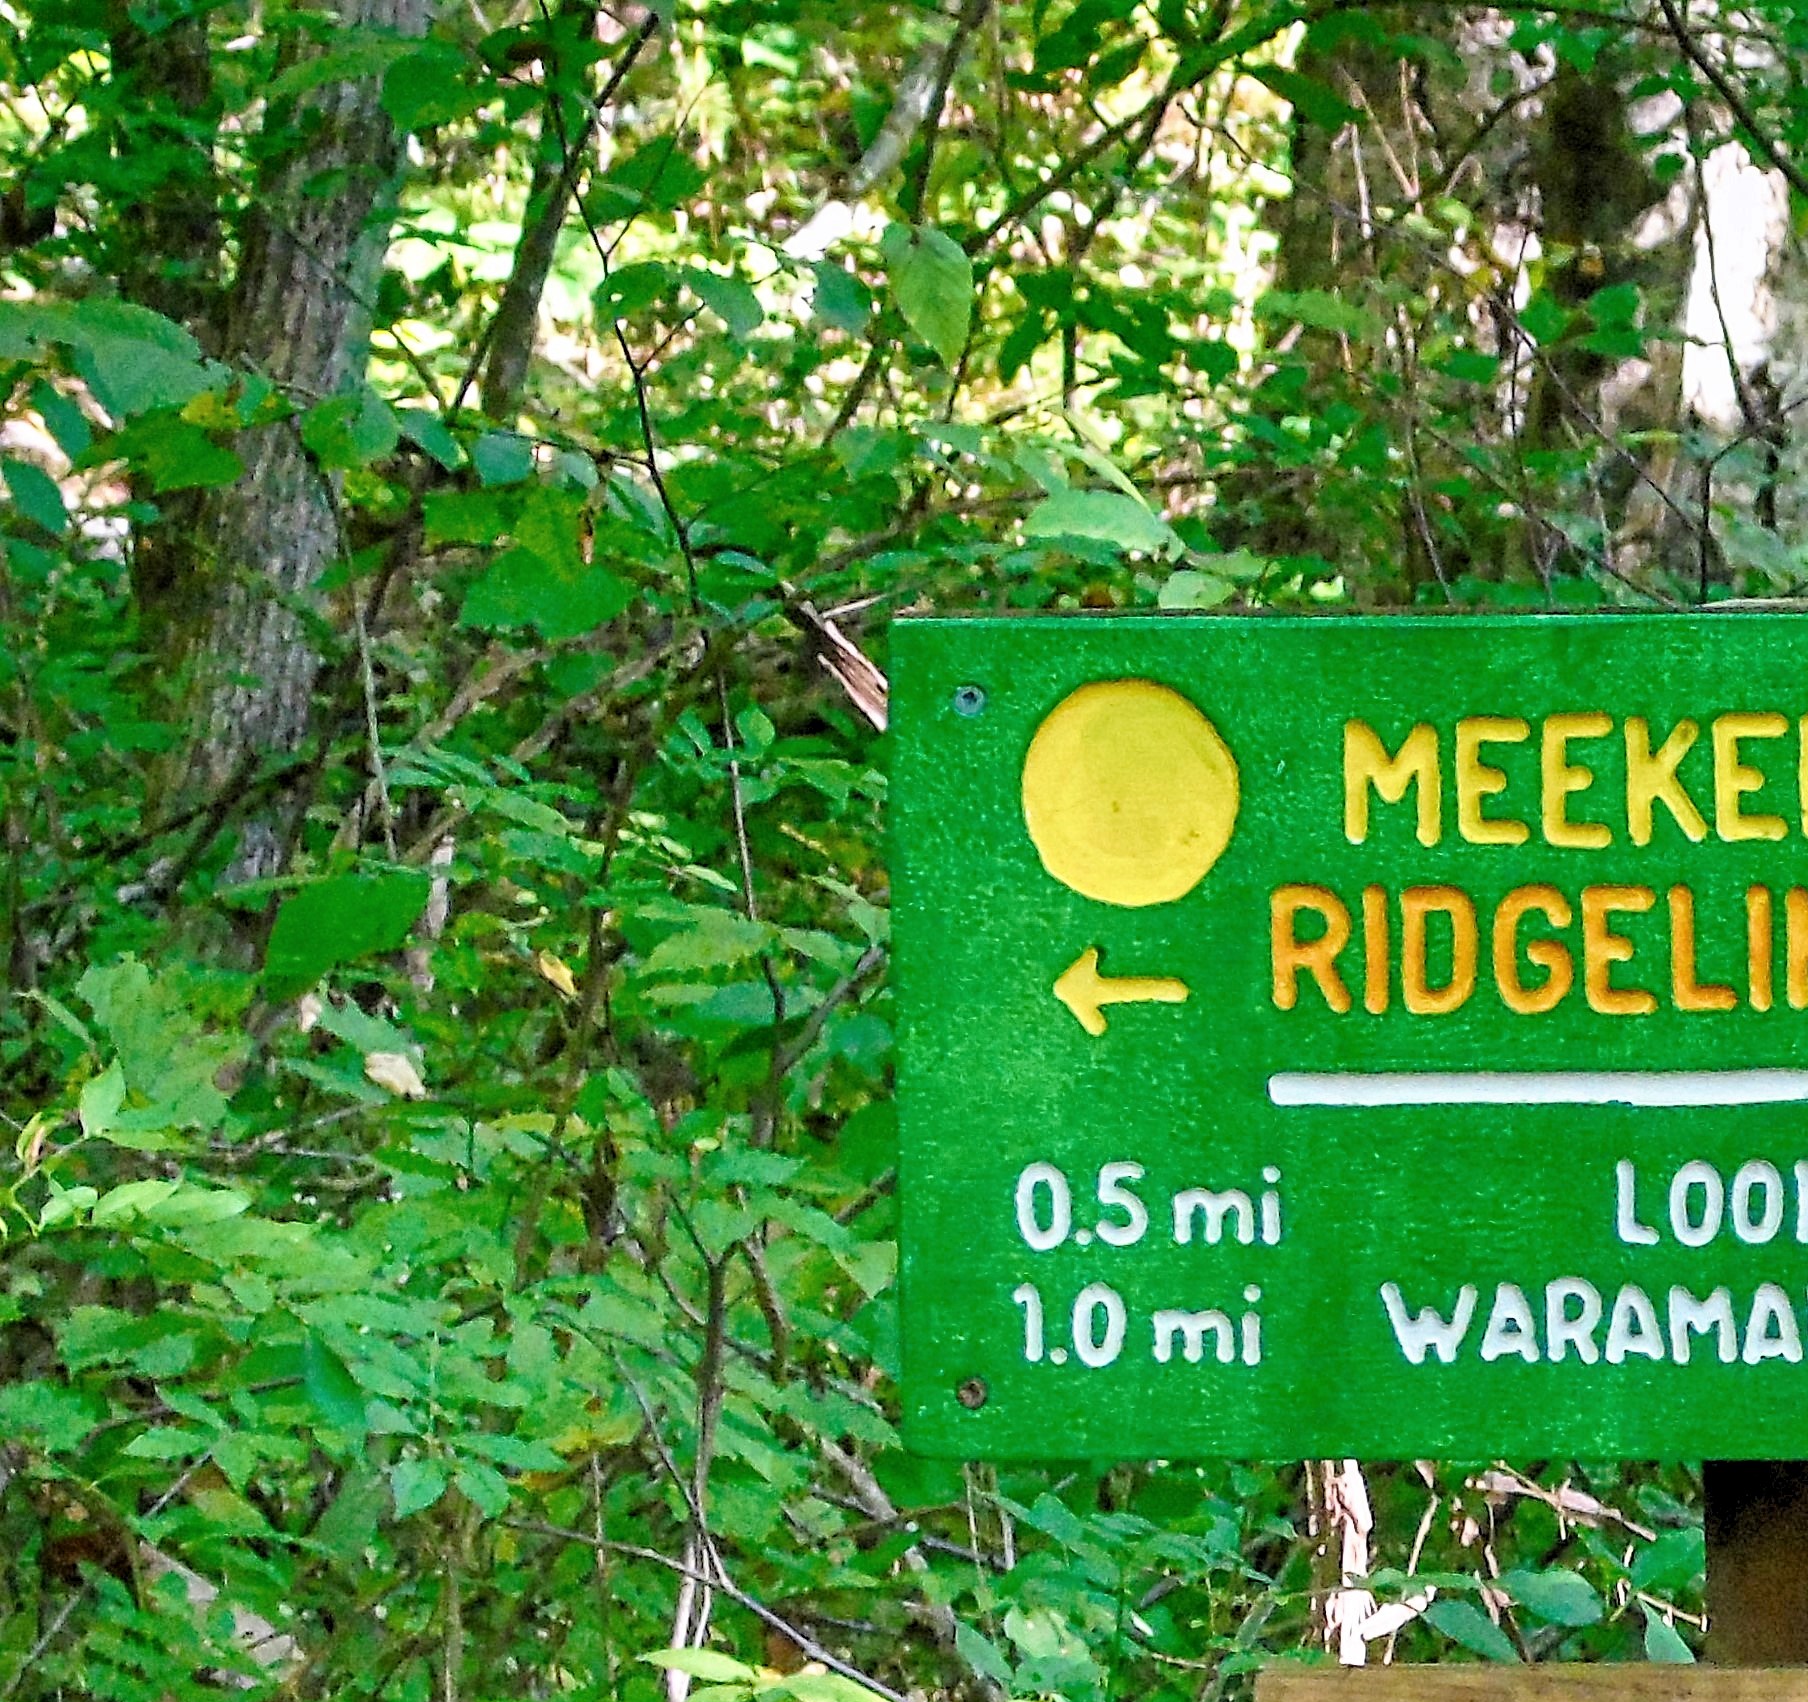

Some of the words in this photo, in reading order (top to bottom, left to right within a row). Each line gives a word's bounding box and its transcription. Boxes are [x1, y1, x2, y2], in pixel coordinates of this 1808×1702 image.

[1015, 1161, 1148, 1250] 0.5
[1173, 1165, 1281, 1244] mi
[1013, 1282, 1127, 1367] 1.0
[1153, 1284, 1261, 1365] mi
